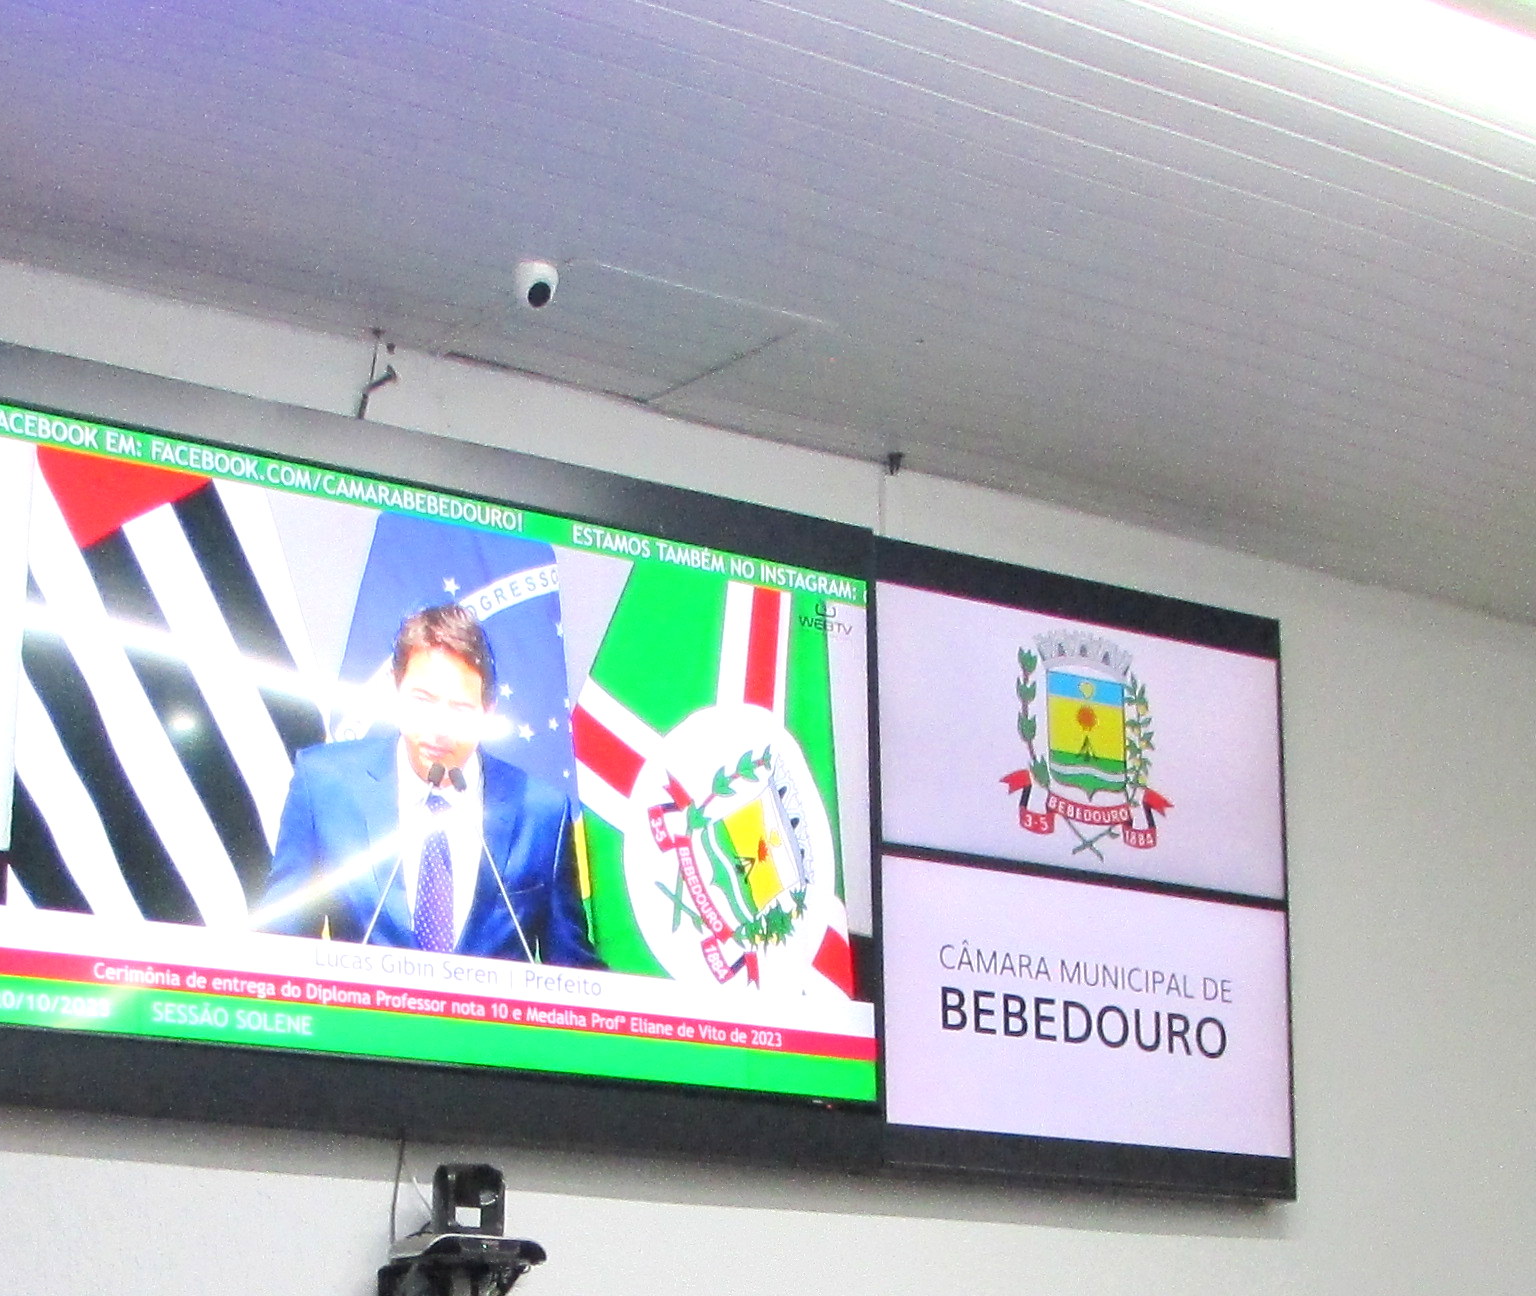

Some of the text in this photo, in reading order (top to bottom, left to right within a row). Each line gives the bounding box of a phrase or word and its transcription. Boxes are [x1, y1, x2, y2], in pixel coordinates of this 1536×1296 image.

[105, 431, 143, 457] EM:
[572, 524, 651, 559] ESTAMOS
[656, 541, 725, 574] TAMBÉM
[730, 557, 754, 579] NO
[760, 563, 857, 601] INSTAGRAM:
[1048, 796, 1129, 824] BEBEDOURO
[525, 970, 602, 997] Prefeito
[939, 939, 1233, 1004] CÂMARA MUNICIPAL DE
[93, 962, 180, 987] Cerimônia
[186, 972, 207, 989] de
[212, 977, 276, 998] entrega
[280, 981, 301, 998] do
[306, 983, 371, 1005] Diploma
[376, 990, 446, 1013] Professor
[451, 1001, 485, 1017] nota
[491, 1003, 508, 1019] 10
[512, 1010, 522, 1021] e
[526, 1007, 586, 1027] Medalha
[630, 1016, 673, 1036] Eliane
[677, 1022, 695, 1038] de
[698, 1023, 726, 1041] Vito
[730, 1028, 747, 1044] de
[751, 1030, 783, 1047] 2023
[151, 1001, 229, 1028] SESSÃO
[235, 1009, 313, 1036] SOLENE
[940, 987, 1227, 1059] BEBEDOURO
